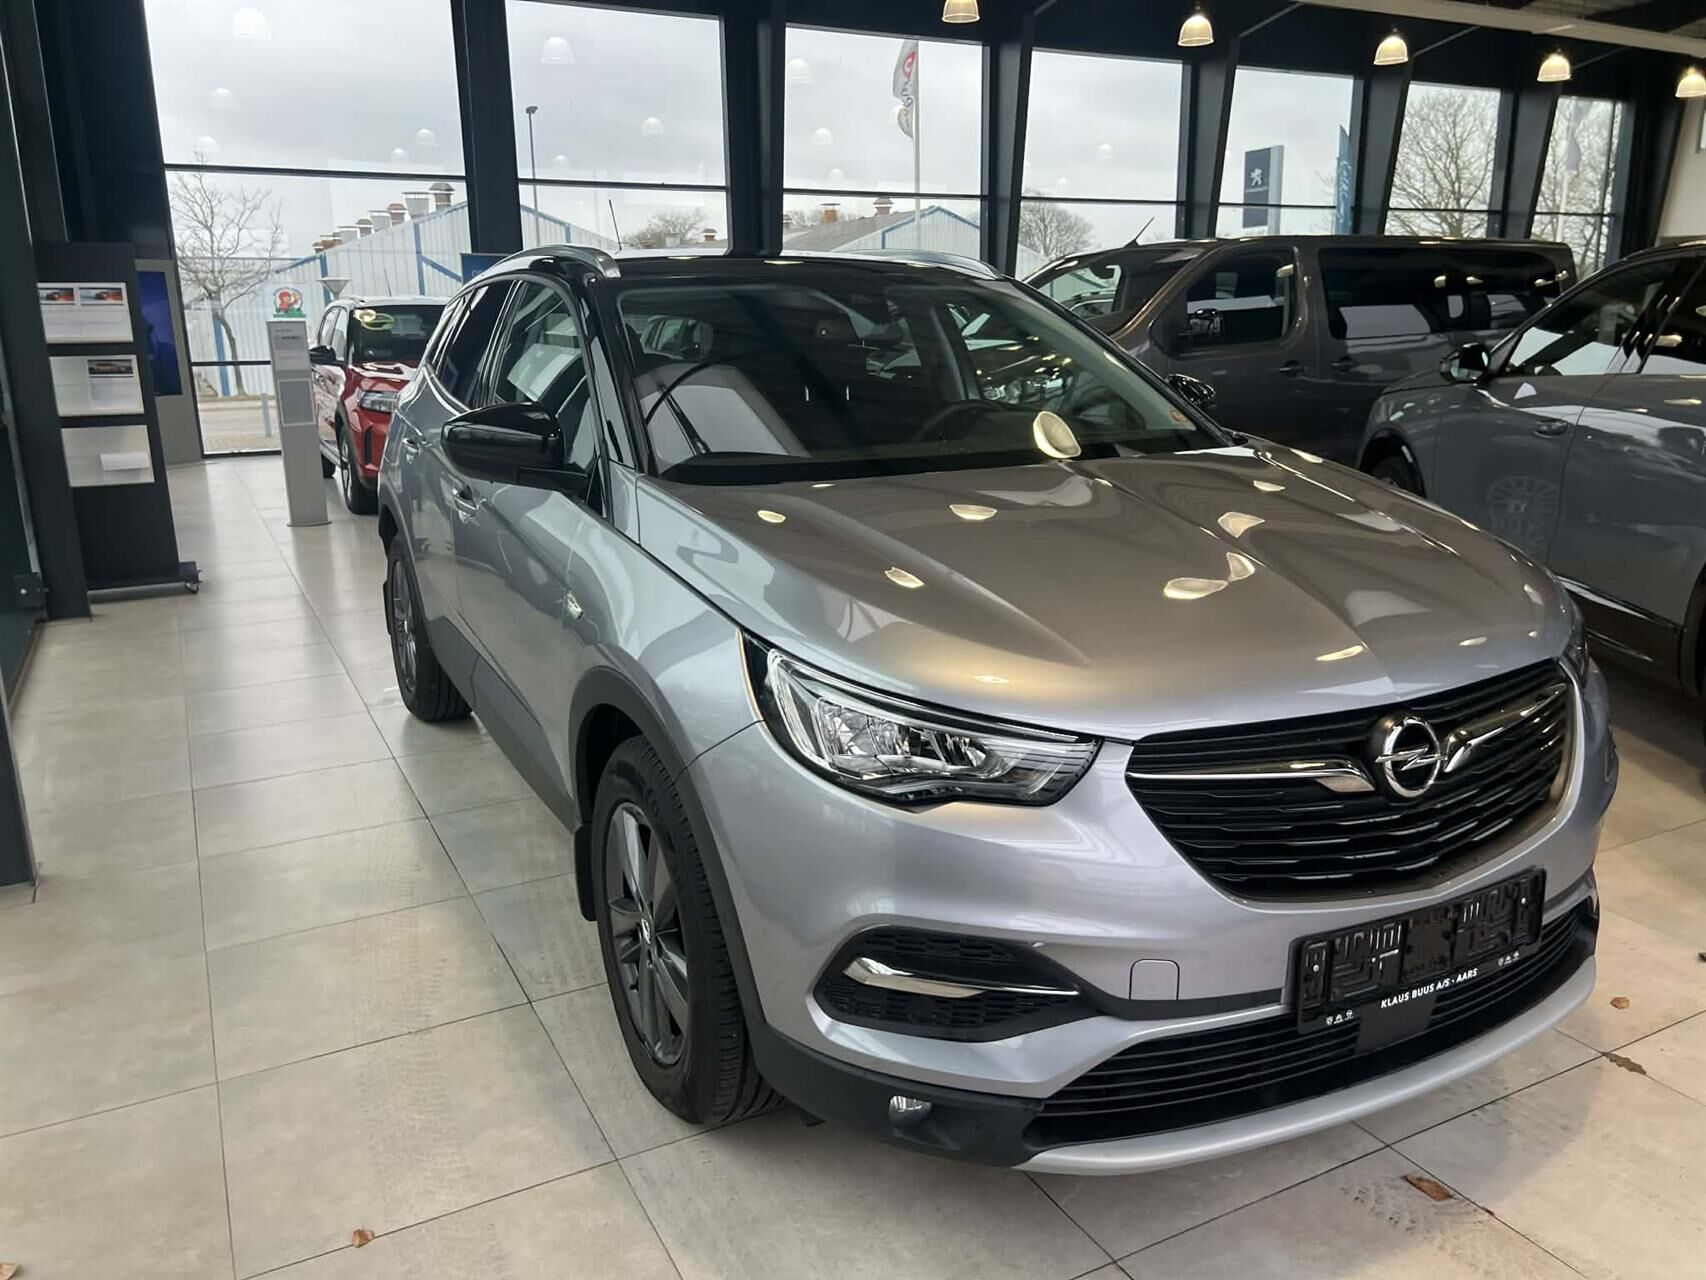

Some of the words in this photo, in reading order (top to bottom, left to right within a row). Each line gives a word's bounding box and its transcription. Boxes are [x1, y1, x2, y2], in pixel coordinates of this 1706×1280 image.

[1381, 992, 1409, 1008] KLAUS
[1411, 983, 1434, 999] BUUS
[1436, 978, 1450, 990] A/S
[1456, 968, 1478, 983] AARS
